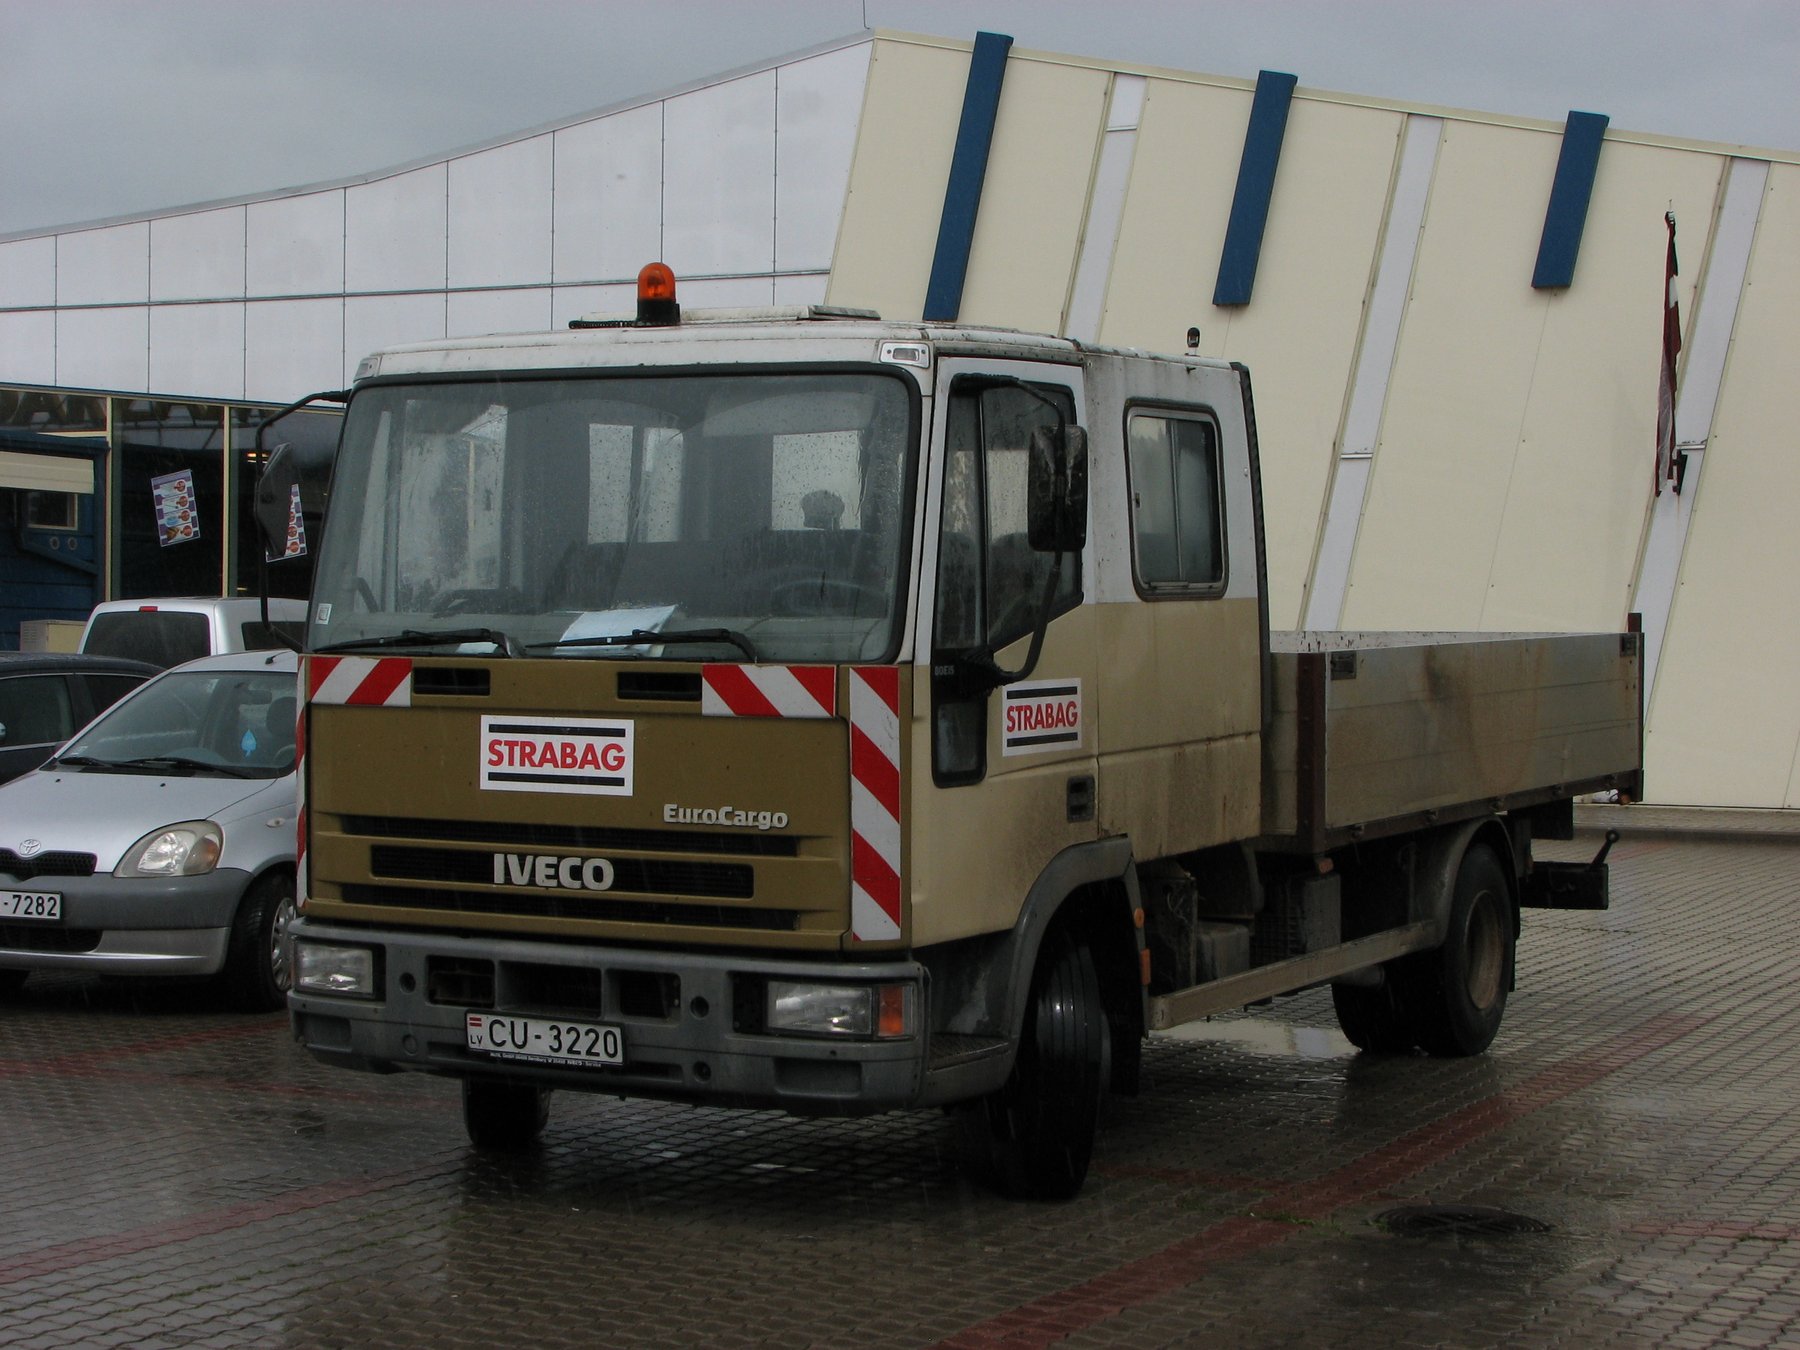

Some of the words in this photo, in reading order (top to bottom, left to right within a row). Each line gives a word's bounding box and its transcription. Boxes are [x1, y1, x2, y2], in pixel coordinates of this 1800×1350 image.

[1006, 701, 1078, 733] STRABAG
[487, 739, 626, 772] STRABAG
[663, 803, 789, 830] EuroCargo
[493, 853, 615, 891] IVECO
[469, 1034, 483, 1046] LV
[488, 1018, 619, 1059] CU-3220
